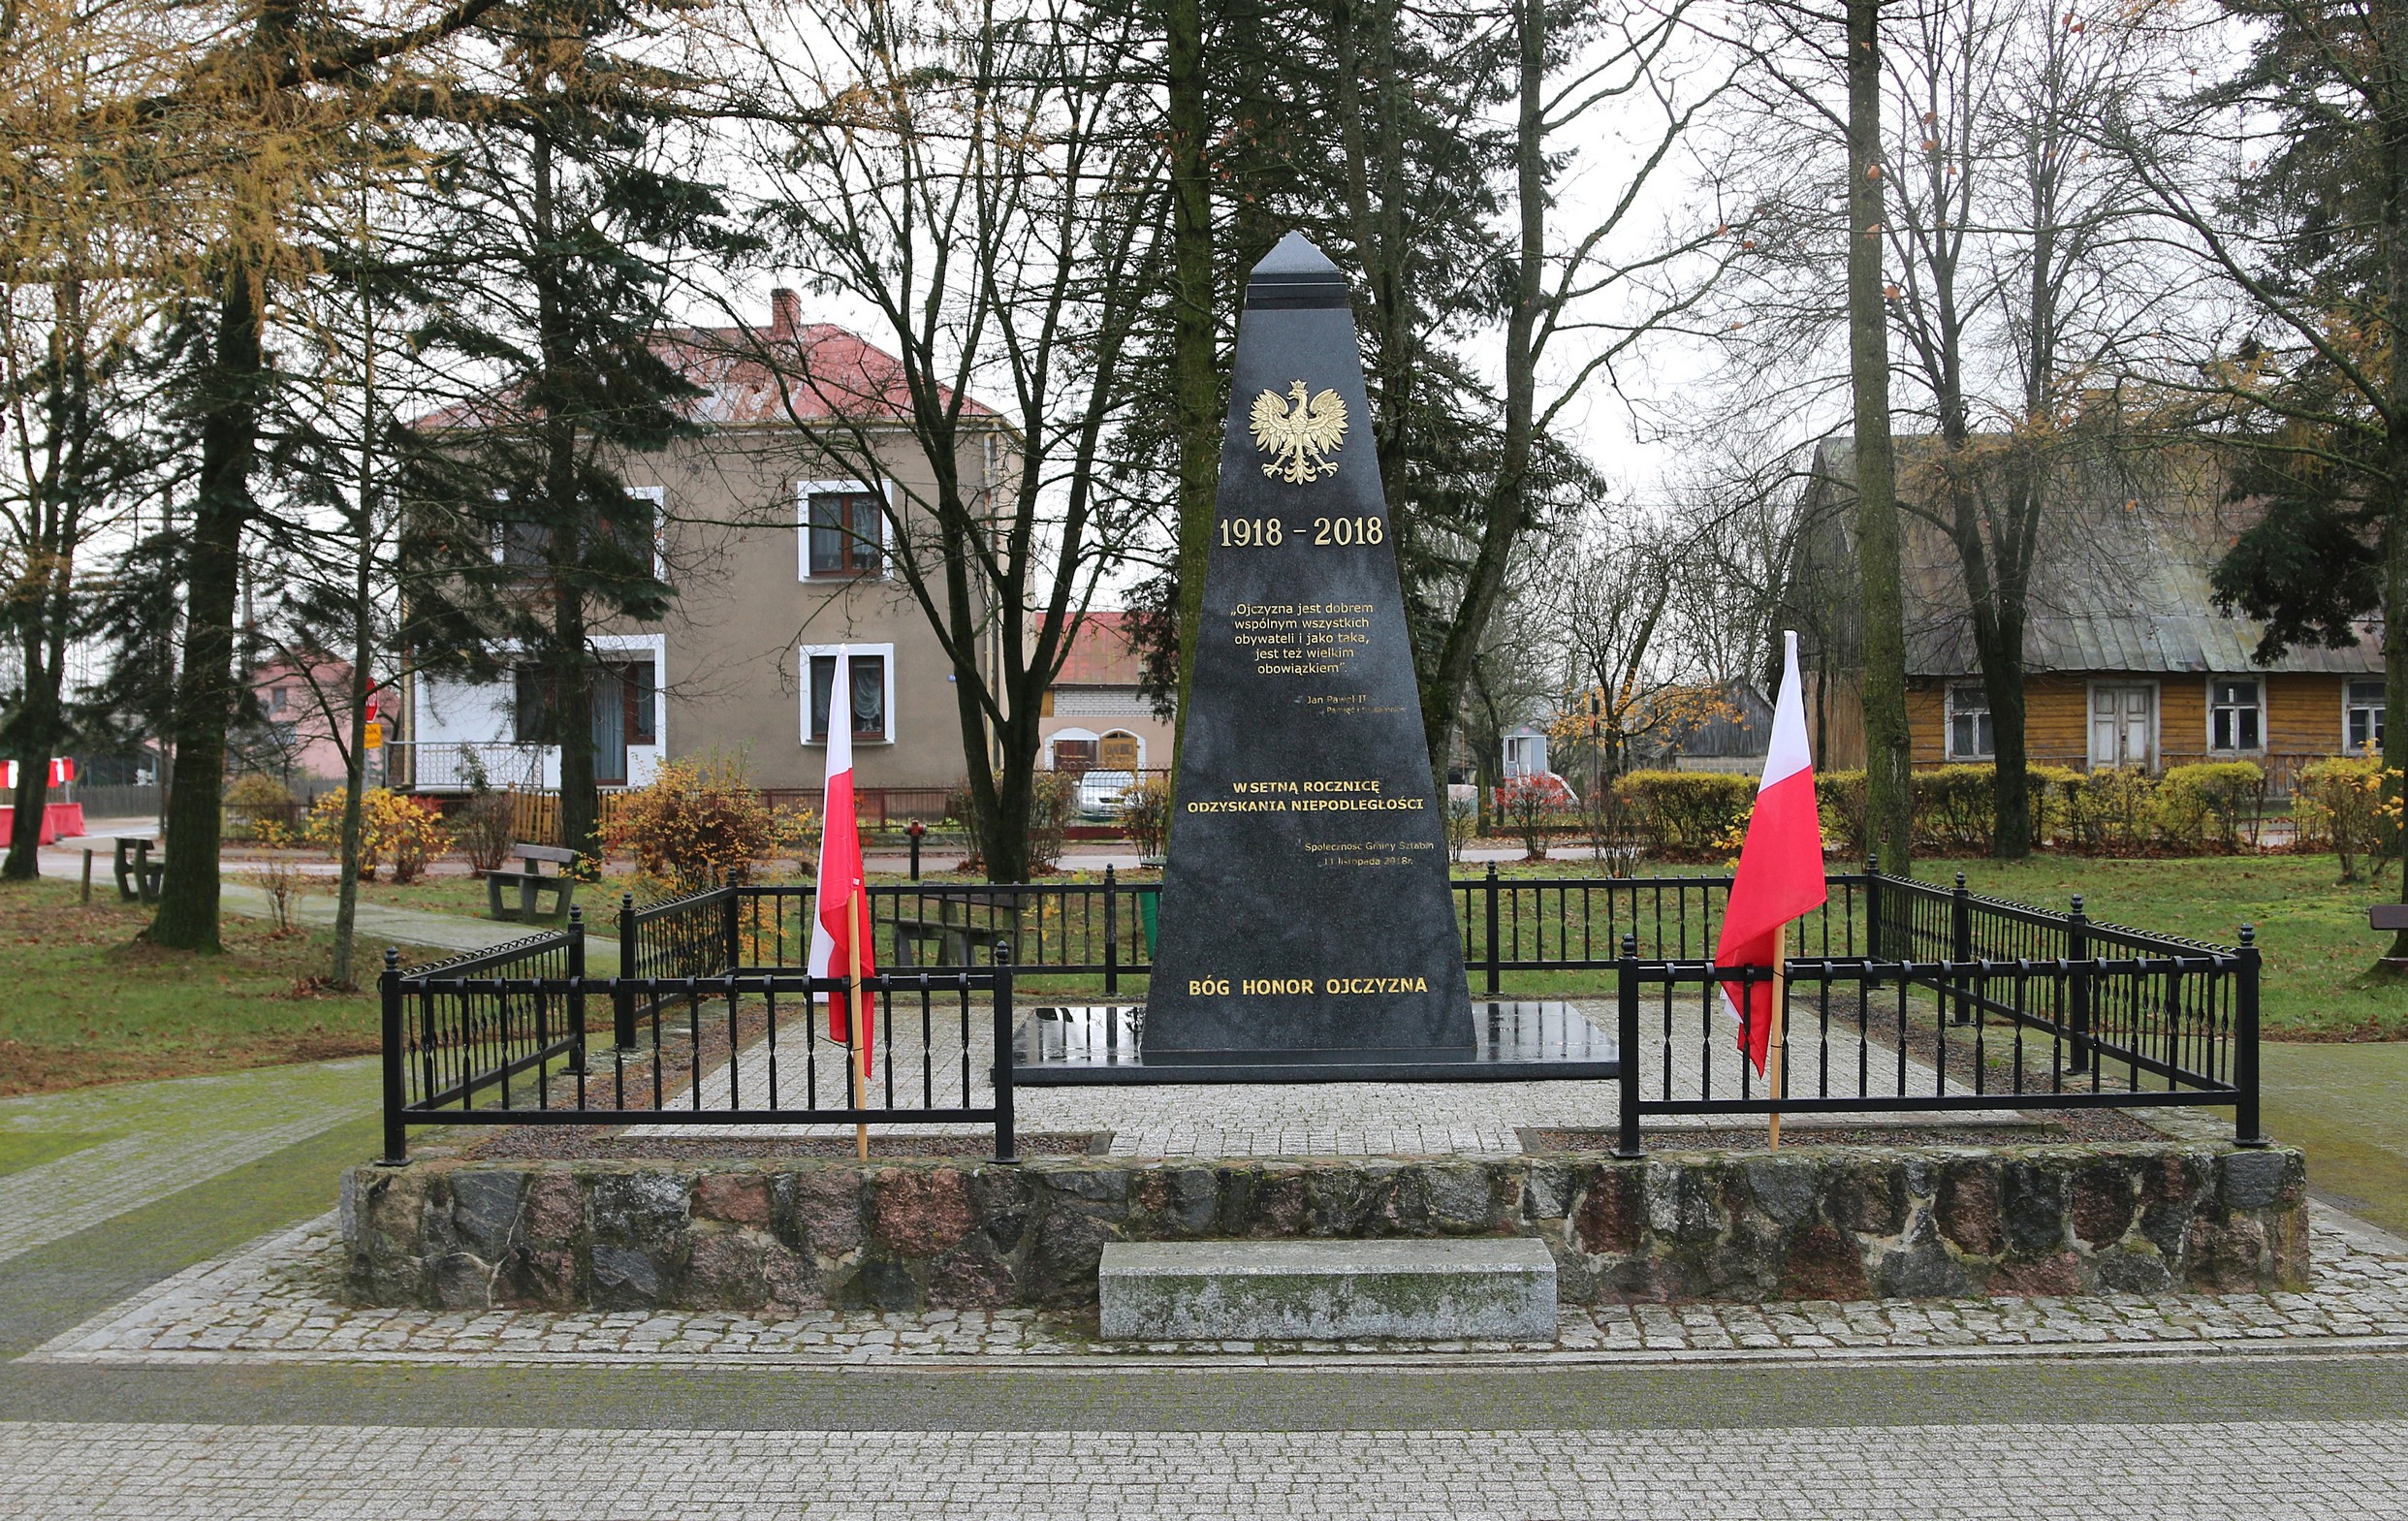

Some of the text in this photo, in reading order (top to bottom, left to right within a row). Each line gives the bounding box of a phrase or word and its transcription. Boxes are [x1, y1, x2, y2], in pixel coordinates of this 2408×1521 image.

[1220, 518, 1283, 547] 1918
[1314, 517, 1384, 546] 2018
[1230, 602, 1374, 617] „Ojczyzna jest dobrem
[1234, 618, 1370, 631] wspólnym wszystkich
[1234, 632, 1370, 646] obywateli i jako taka,
[1254, 647, 1354, 661] jest też wielkim
[1307, 695, 1324, 705] Jan
[1358, 694, 1367, 704] II
[1232, 780, 1380, 795] W SETNĄ ROCZNICĘ
[1188, 797, 1424, 813] ODZYSKANIA NIEPODLEGŁOŚCI
[1365, 841, 1396, 852] Gminy
[1399, 840, 1435, 850] Sztabin
[1324, 857, 1334, 866] 11
[1338, 857, 1381, 867] listopada
[1188, 974, 1429, 996] BÓG HONOR OJCZYZNA
